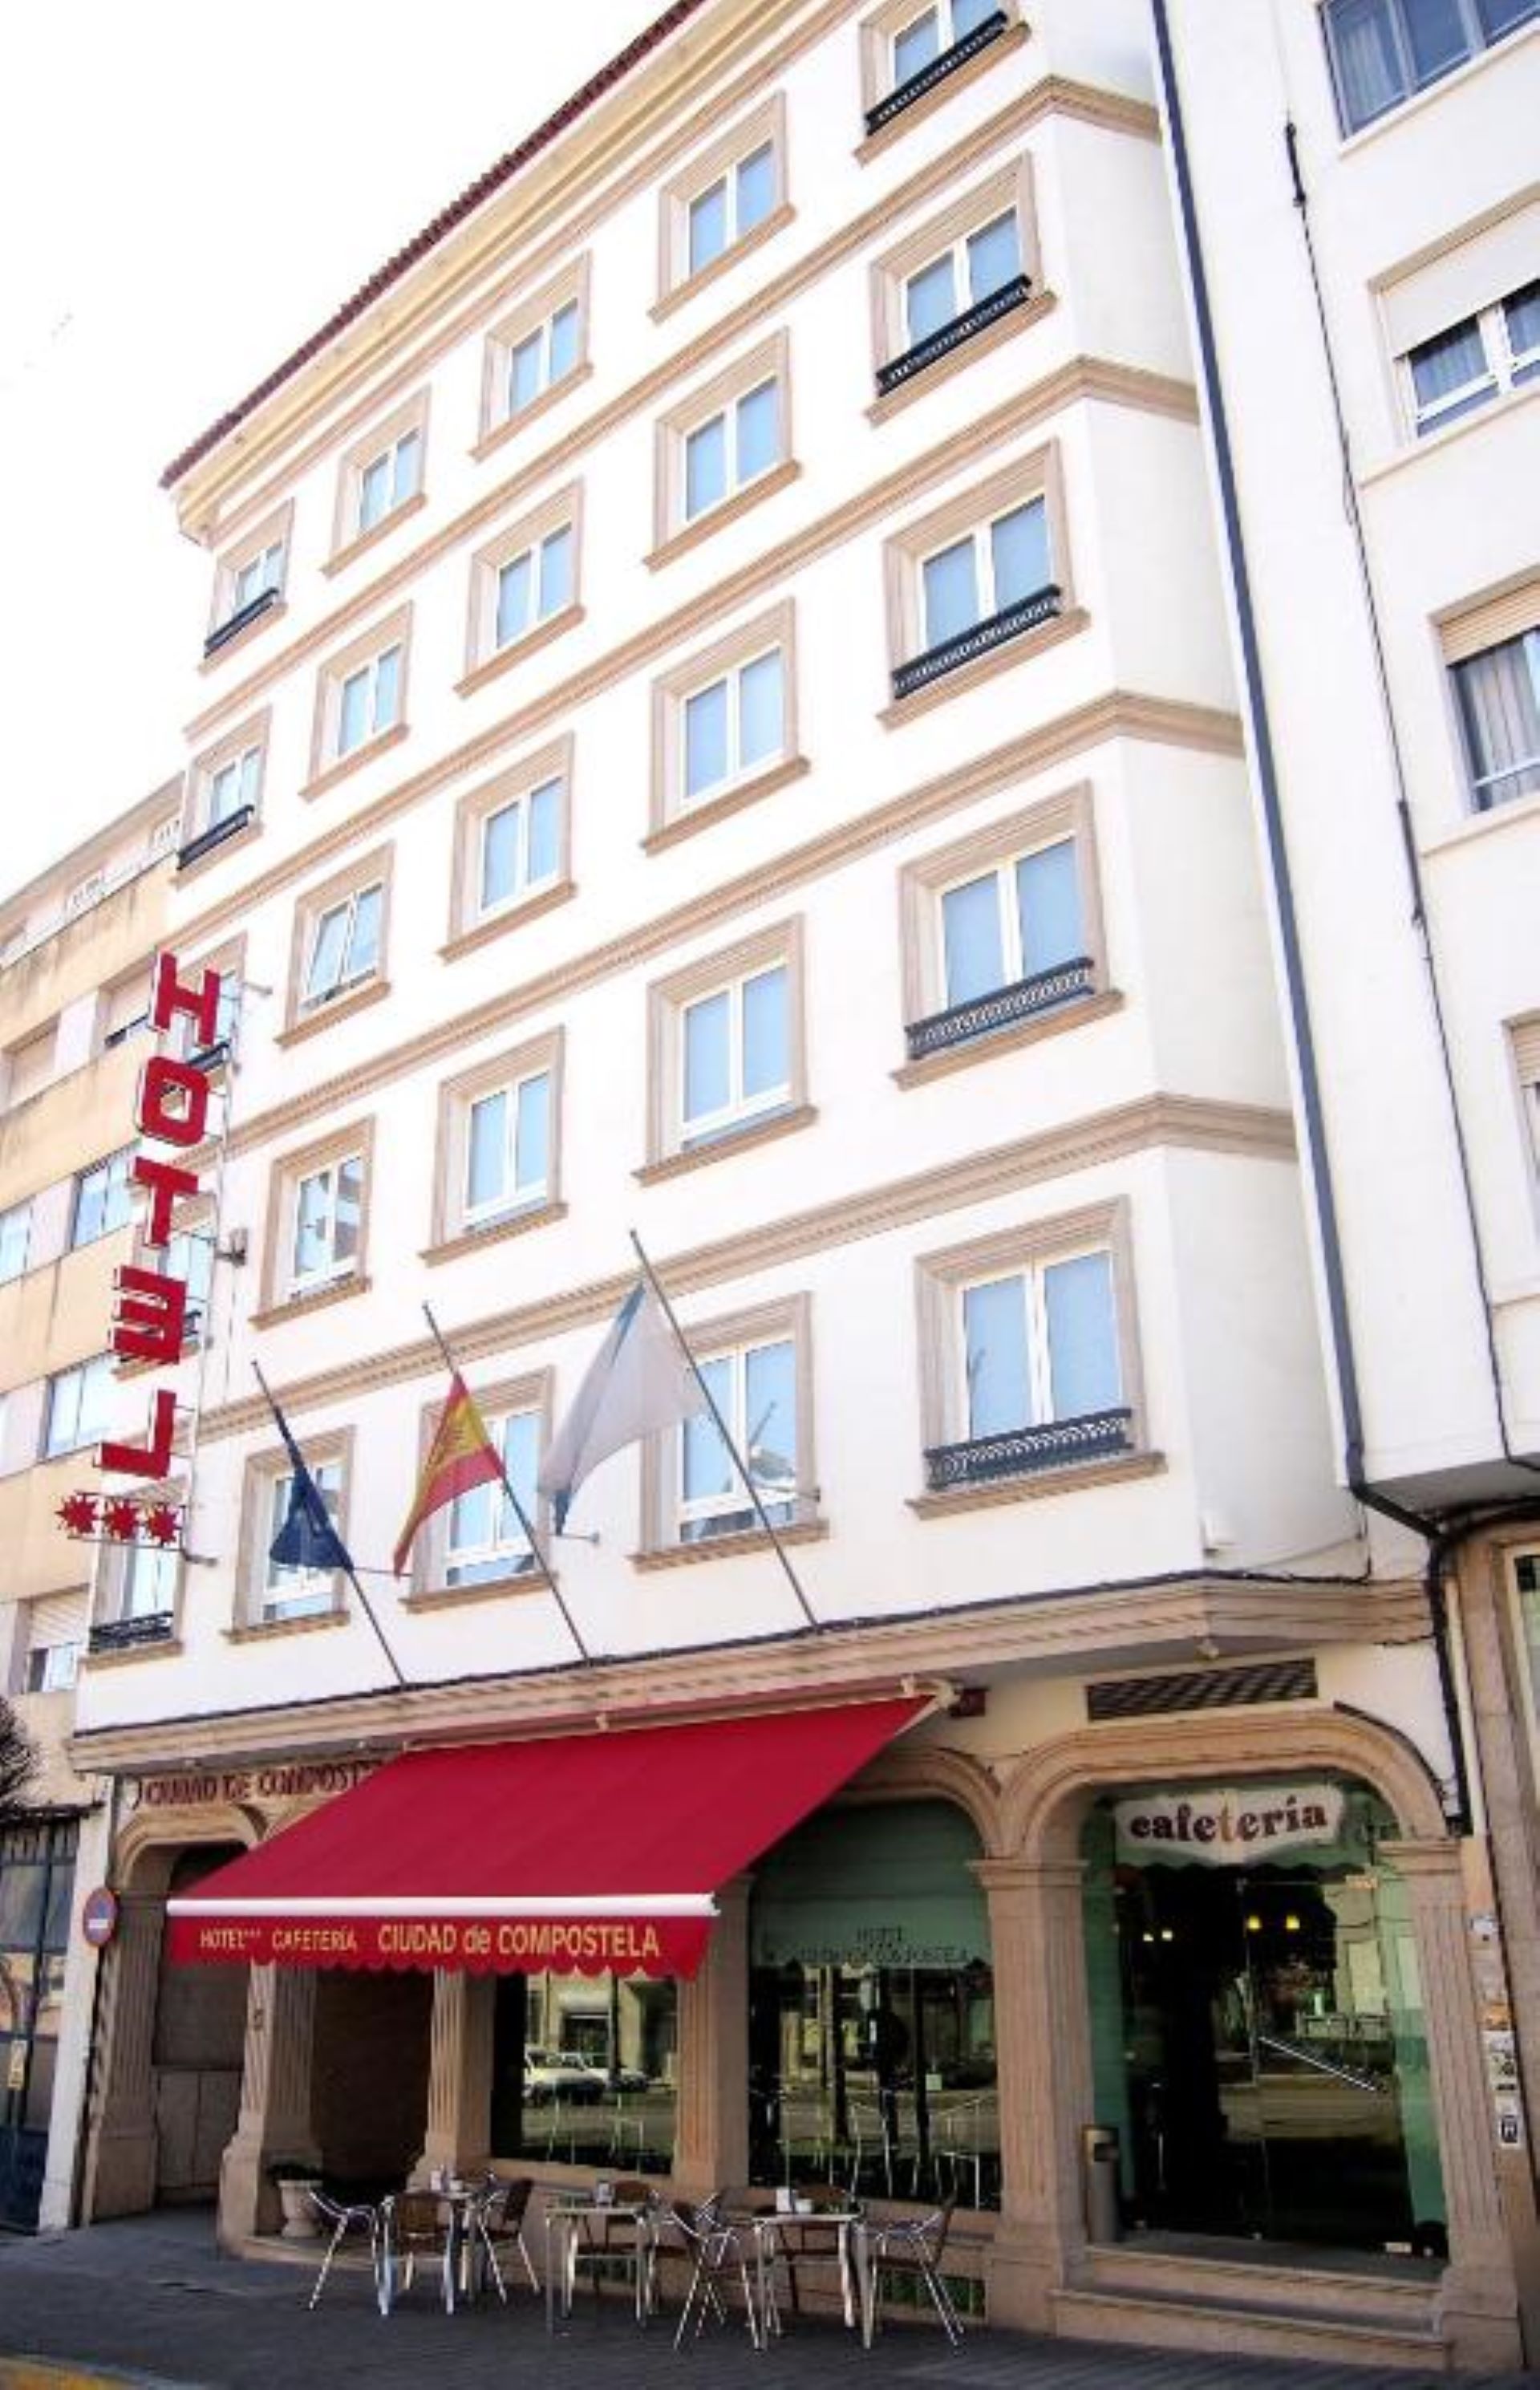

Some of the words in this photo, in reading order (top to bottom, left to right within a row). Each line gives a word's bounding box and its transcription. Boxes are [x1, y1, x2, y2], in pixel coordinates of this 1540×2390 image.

[258, 1759, 382, 1796] COMPOST
[1129, 1794, 1328, 1843] cafetería
[378, 1924, 457, 1953] CIUDAD
[463, 1926, 490, 1953] de
[498, 1924, 660, 1958] COMPOSTELA
